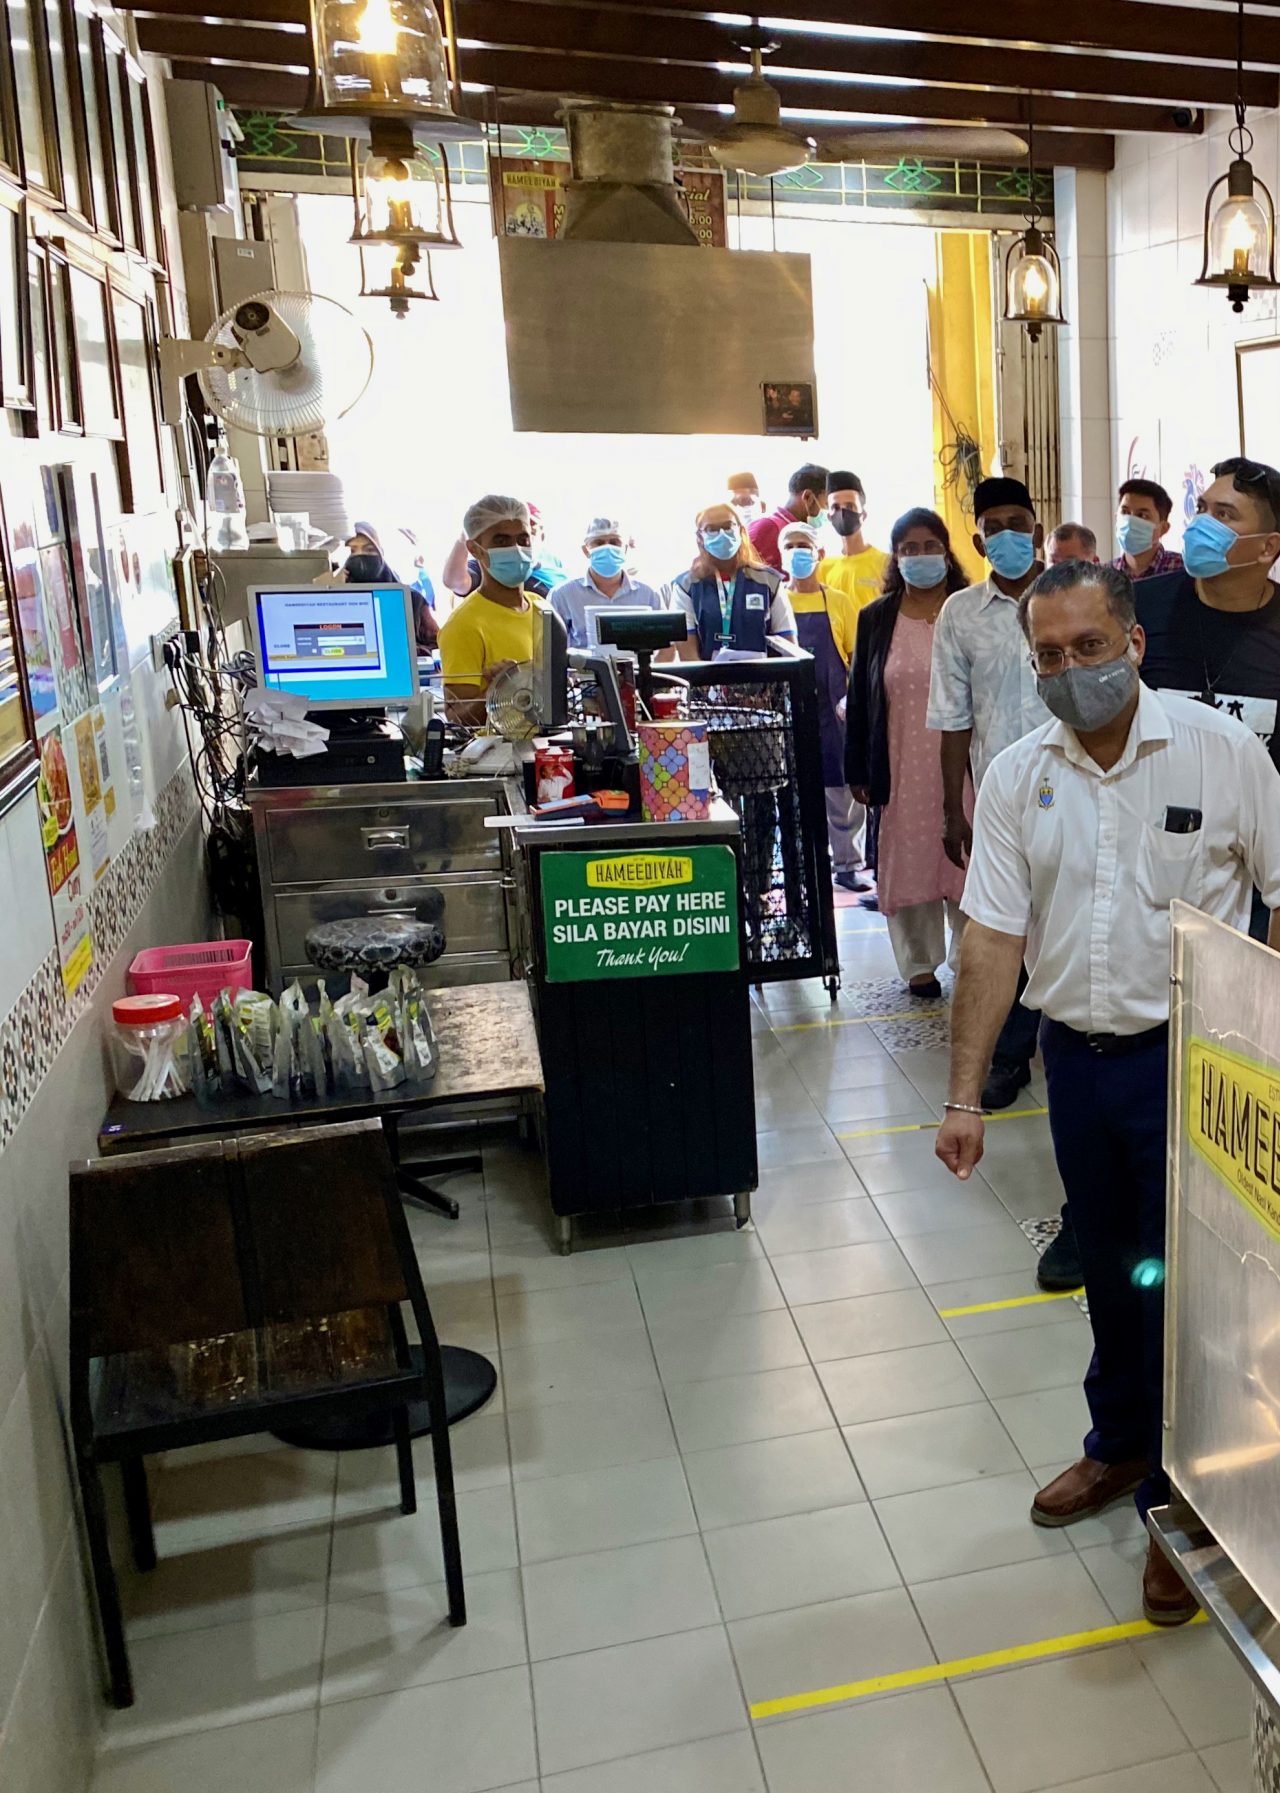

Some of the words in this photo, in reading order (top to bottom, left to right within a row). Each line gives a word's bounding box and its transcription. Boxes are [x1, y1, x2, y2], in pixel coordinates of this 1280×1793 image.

[595, 858, 684, 883] HAMEEDIYAH
[555, 897, 630, 918] PLEASE
[635, 894, 671, 914] PAY
[677, 891, 726, 911] HERE
[553, 924, 598, 944] SILA
[604, 920, 667, 941] BAYAR
[673, 916, 730, 936] DISINI
[596, 948, 646, 968] Thank
[648, 943, 690, 972] You!
